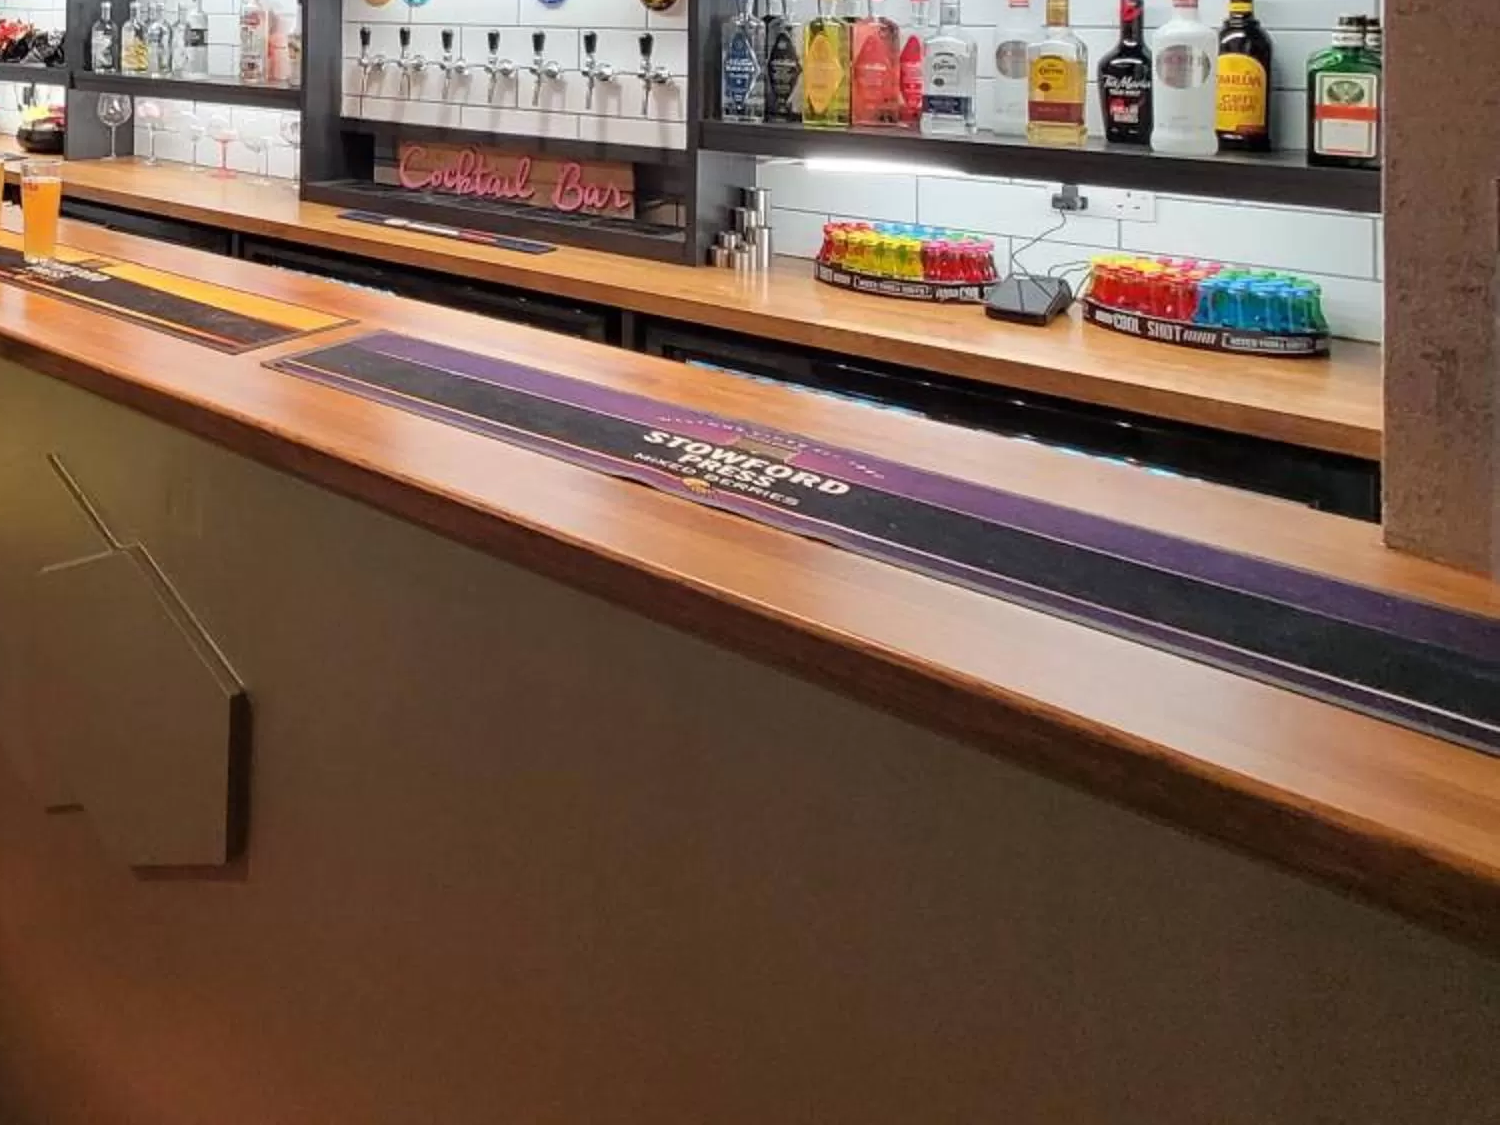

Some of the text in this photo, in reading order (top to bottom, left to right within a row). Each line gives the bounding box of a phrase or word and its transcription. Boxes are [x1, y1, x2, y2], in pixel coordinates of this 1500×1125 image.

[399, 146, 631, 213] Cocktail Bar
[1147, 320, 1184, 342] SHOT
[643, 430, 850, 495] STOWFORD
[677, 453, 777, 488] PRESS
[703, 474, 801, 507] BERRIES
